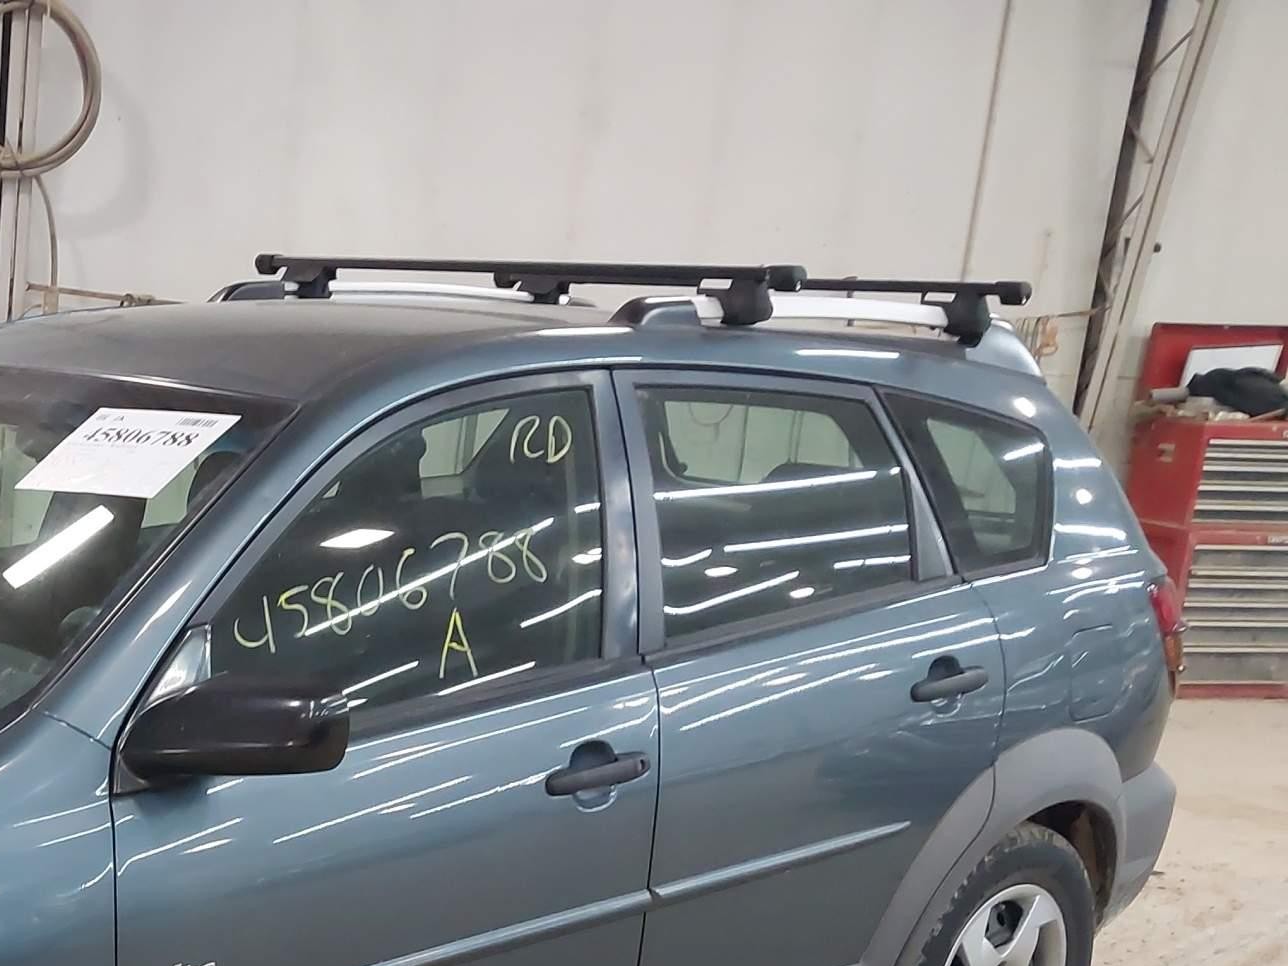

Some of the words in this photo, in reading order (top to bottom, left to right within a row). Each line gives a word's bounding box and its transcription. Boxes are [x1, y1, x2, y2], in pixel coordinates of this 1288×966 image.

[83, 427, 200, 448] 45806788
[234, 528, 548, 653] 45806788
[439, 608, 479, 679] A
